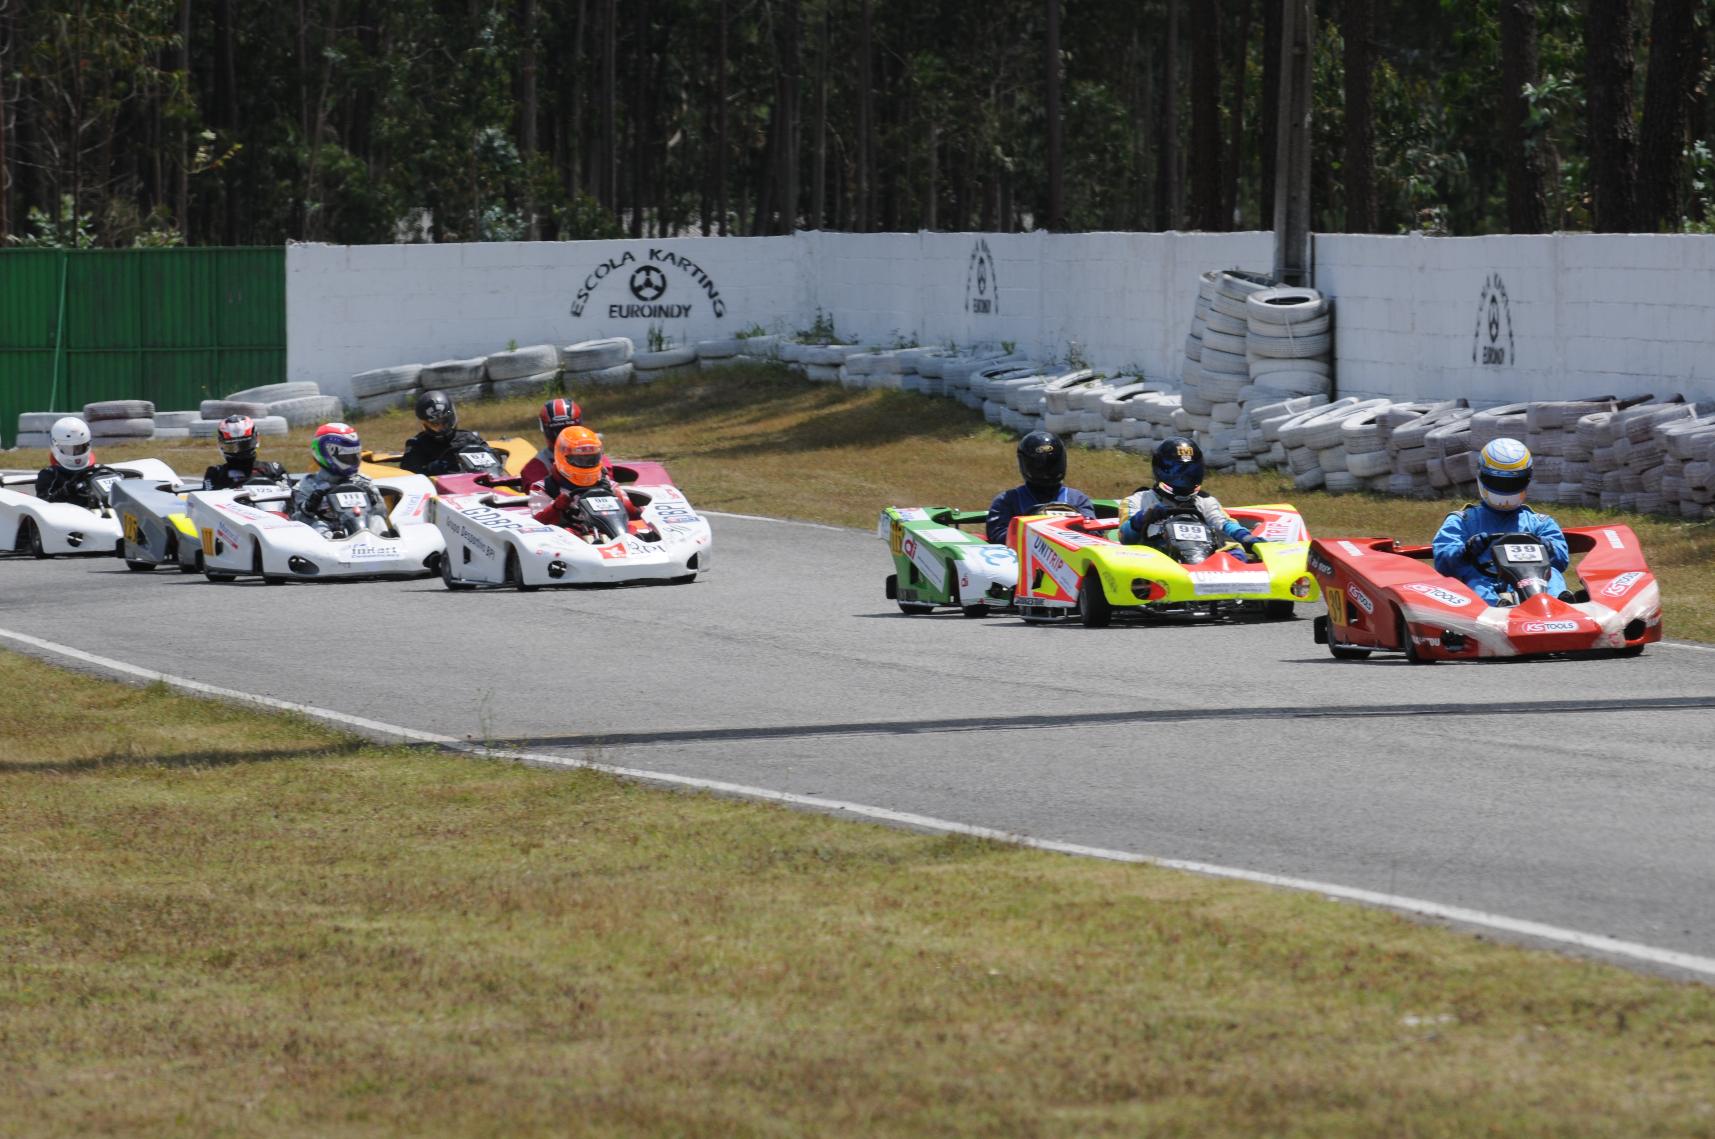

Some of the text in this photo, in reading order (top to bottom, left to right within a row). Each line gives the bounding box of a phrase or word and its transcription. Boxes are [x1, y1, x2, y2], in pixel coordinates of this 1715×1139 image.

[571, 248, 726, 318] ESCOLA KARTING
[609, 304, 692, 318] EUROINDY
[1178, 524, 1203, 534] 99
[1033, 535, 1064, 571] UNITRIP
[1510, 545, 1537, 553] 39
[1328, 589, 1343, 624] 39
